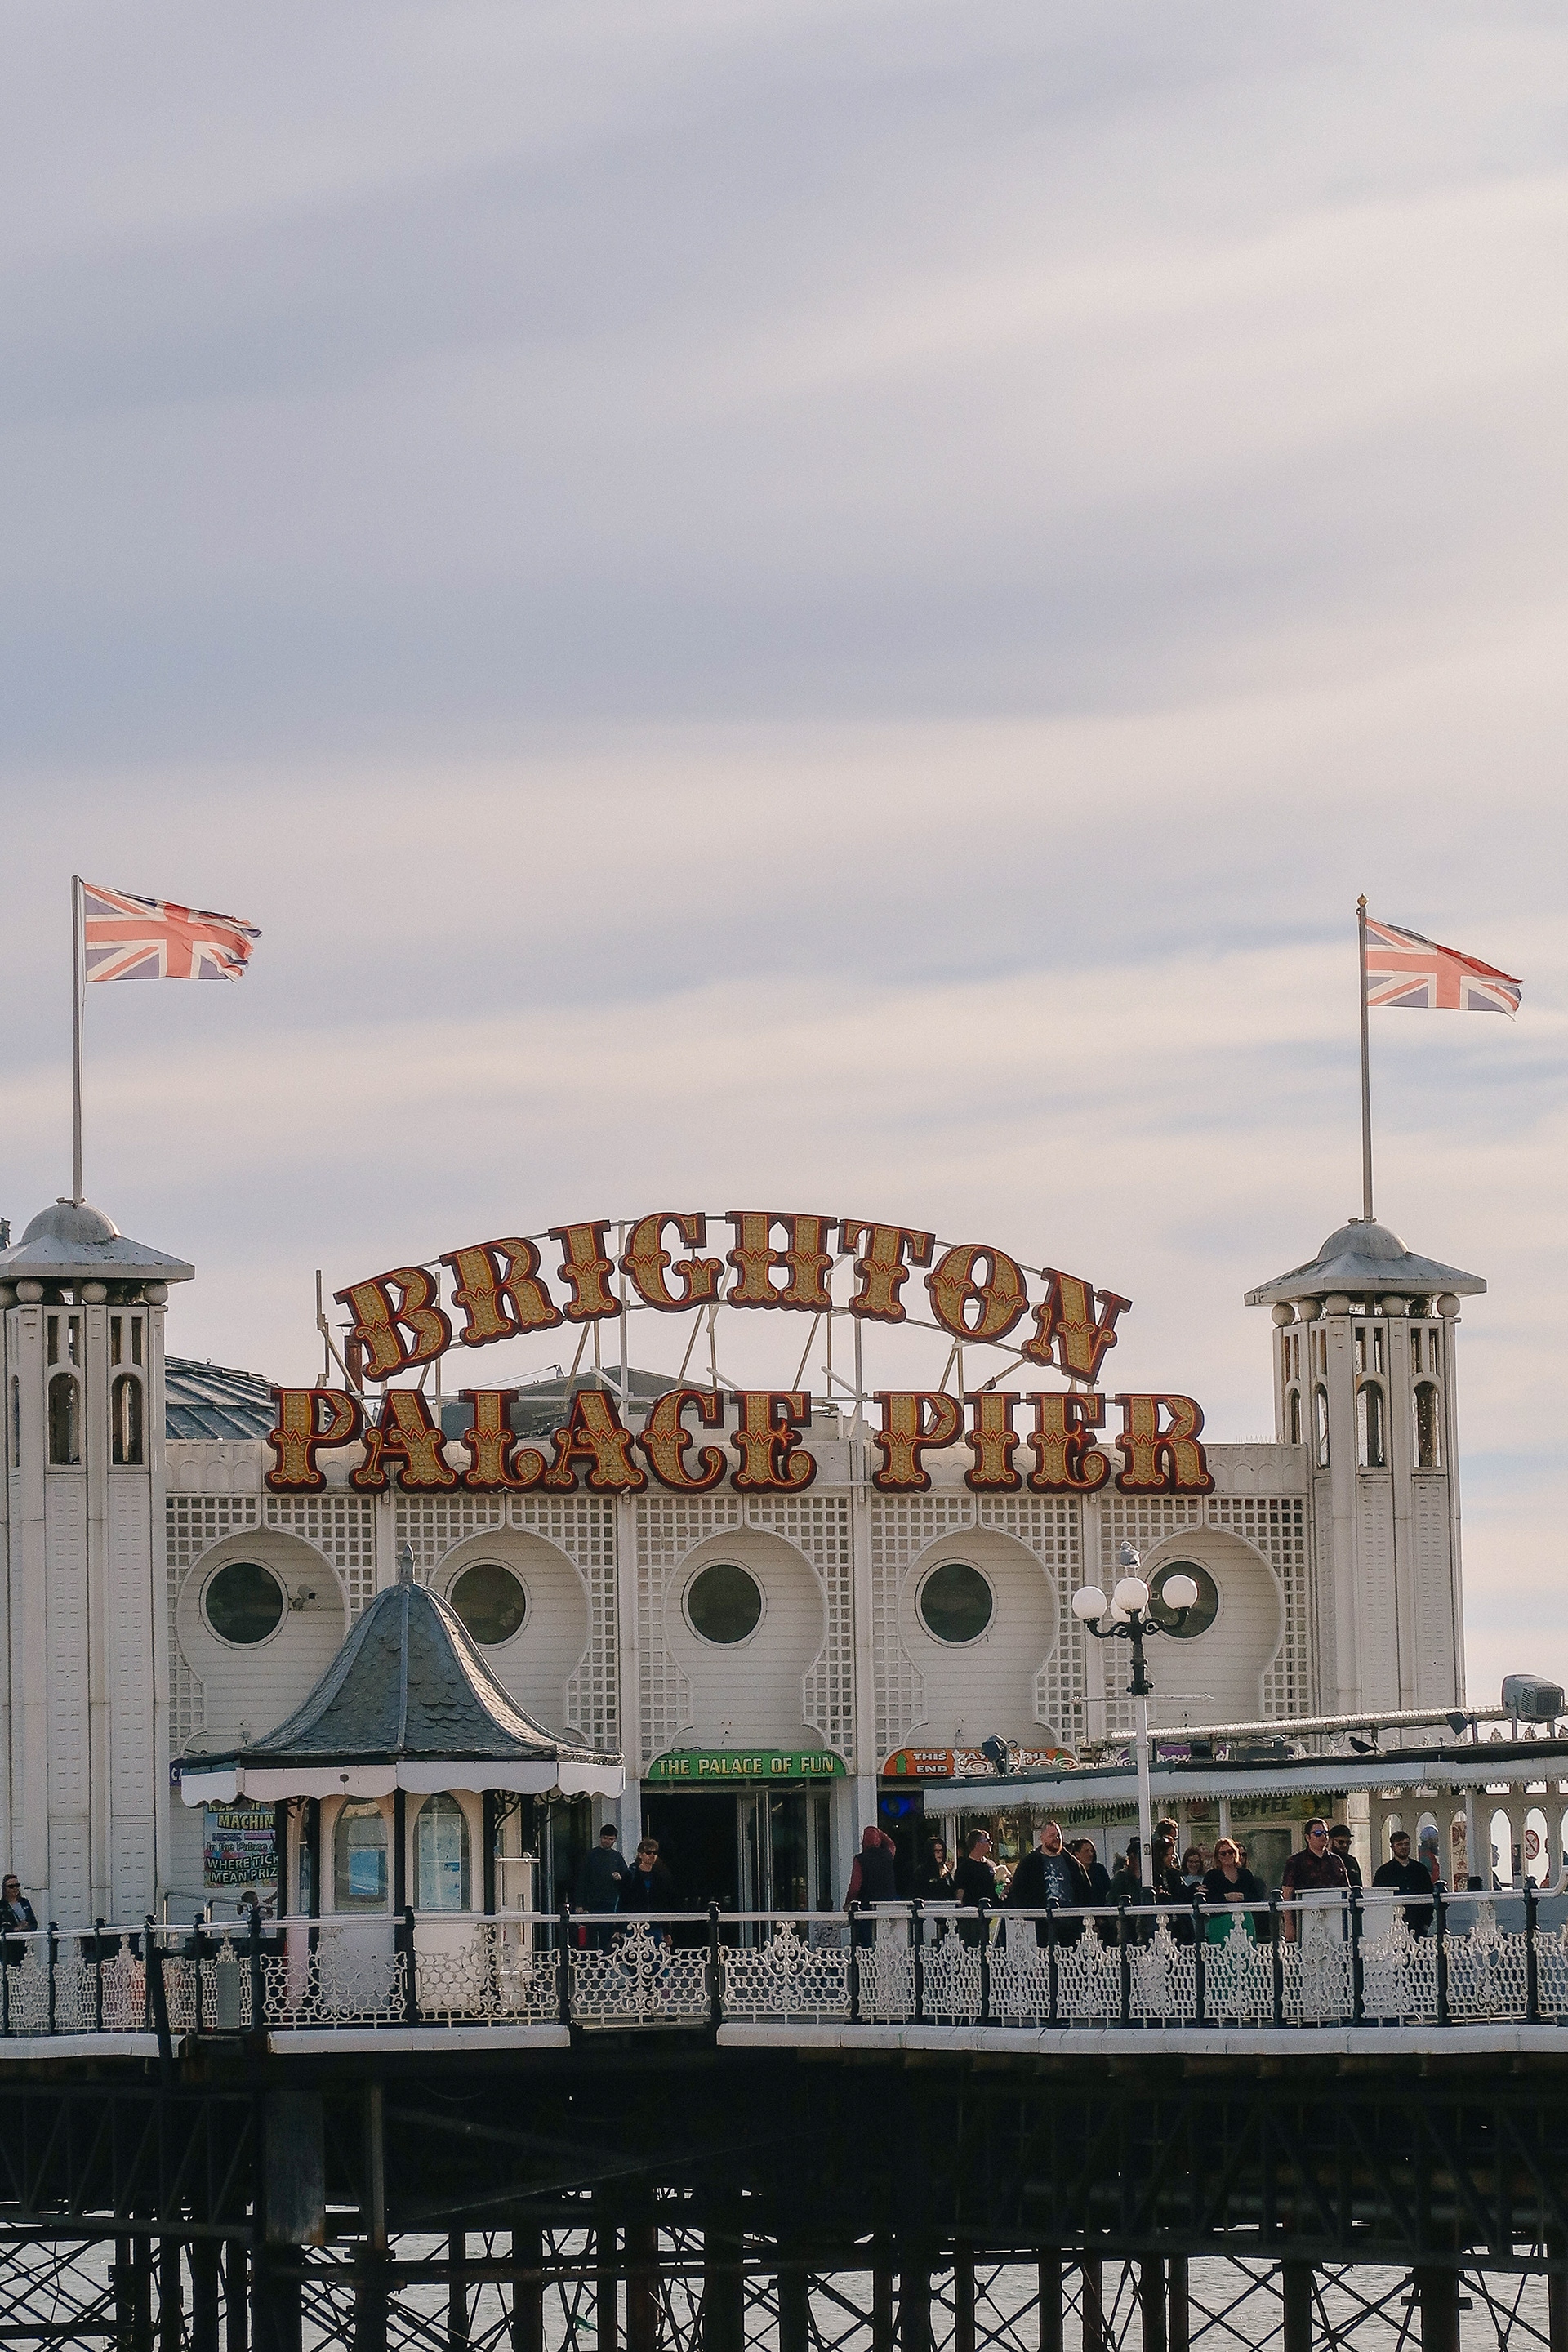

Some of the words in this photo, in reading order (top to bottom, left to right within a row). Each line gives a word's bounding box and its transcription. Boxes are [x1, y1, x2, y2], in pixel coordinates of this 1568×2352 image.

[333, 1212, 1133, 1384] BRIGHTON
[265, 1389, 817, 1494] PALACE
[872, 1391, 1215, 1494] PIER
[913, 1752, 947, 1762] THIS
[658, 1759, 690, 1775] THE
[698, 1757, 763, 1775] PALACE
[771, 1757, 792, 1774] OF
[801, 1757, 835, 1773] FUN
[916, 1765, 947, 1774] END
[1231, 1797, 1291, 1818] COFFEE
[236, 1842, 268, 1851] Palace
[207, 1857, 250, 1870] WHERE
[211, 1871, 247, 1882] MEAN
